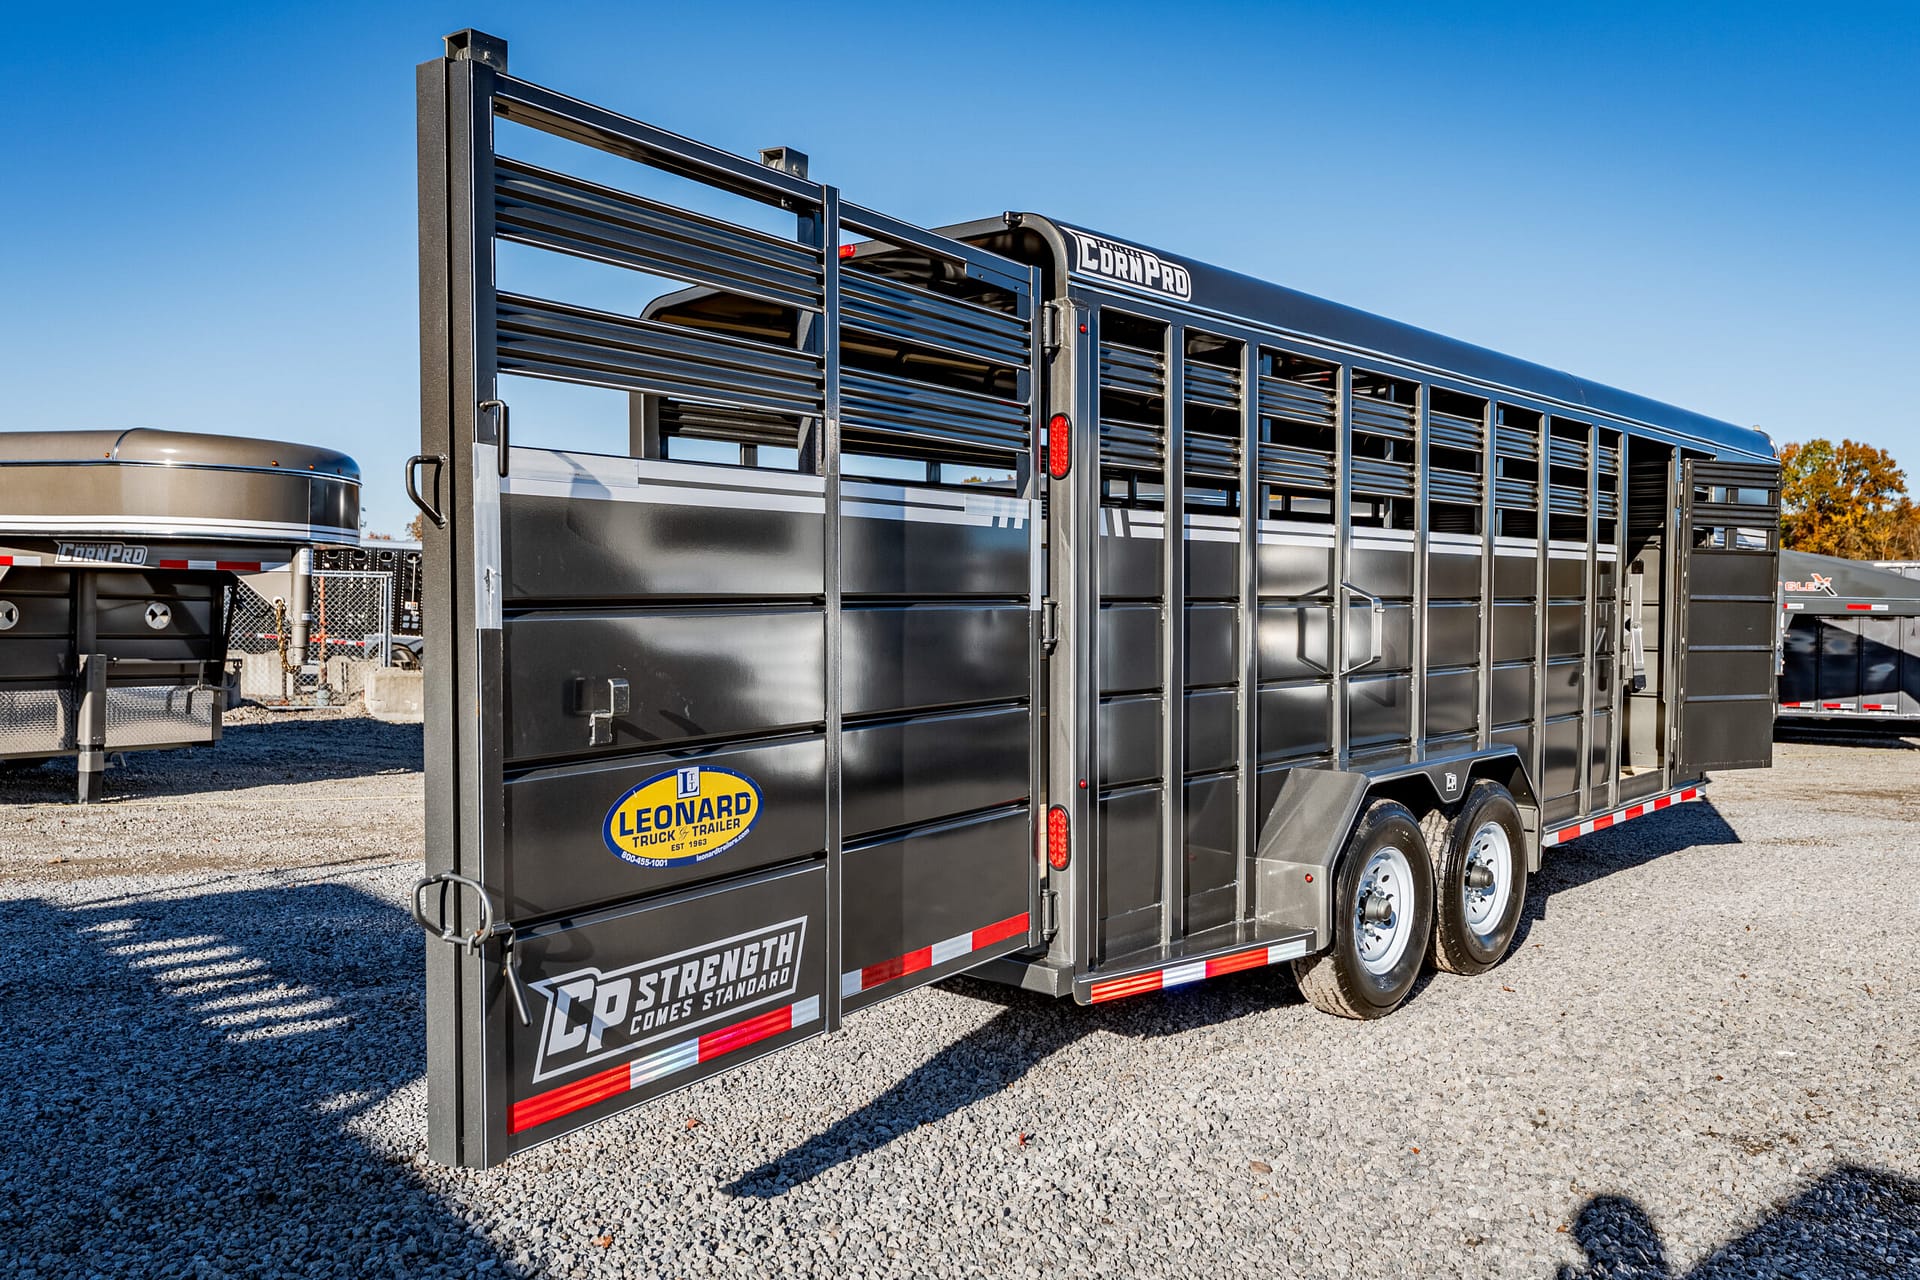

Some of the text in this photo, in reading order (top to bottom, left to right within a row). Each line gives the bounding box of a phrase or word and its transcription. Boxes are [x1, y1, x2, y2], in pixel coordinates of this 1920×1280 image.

[619, 791, 752, 837] LEONARD
[632, 830, 676, 848] TRUCK
[692, 818, 741, 837] TRAILER
[621, 851, 668, 867] 800-455-1001
[671, 838, 708, 852] EST 1963
[634, 931, 796, 1013] STRENGTH
[547, 978, 632, 1056] CP
[629, 966, 790, 1036] COMES STANDARD
